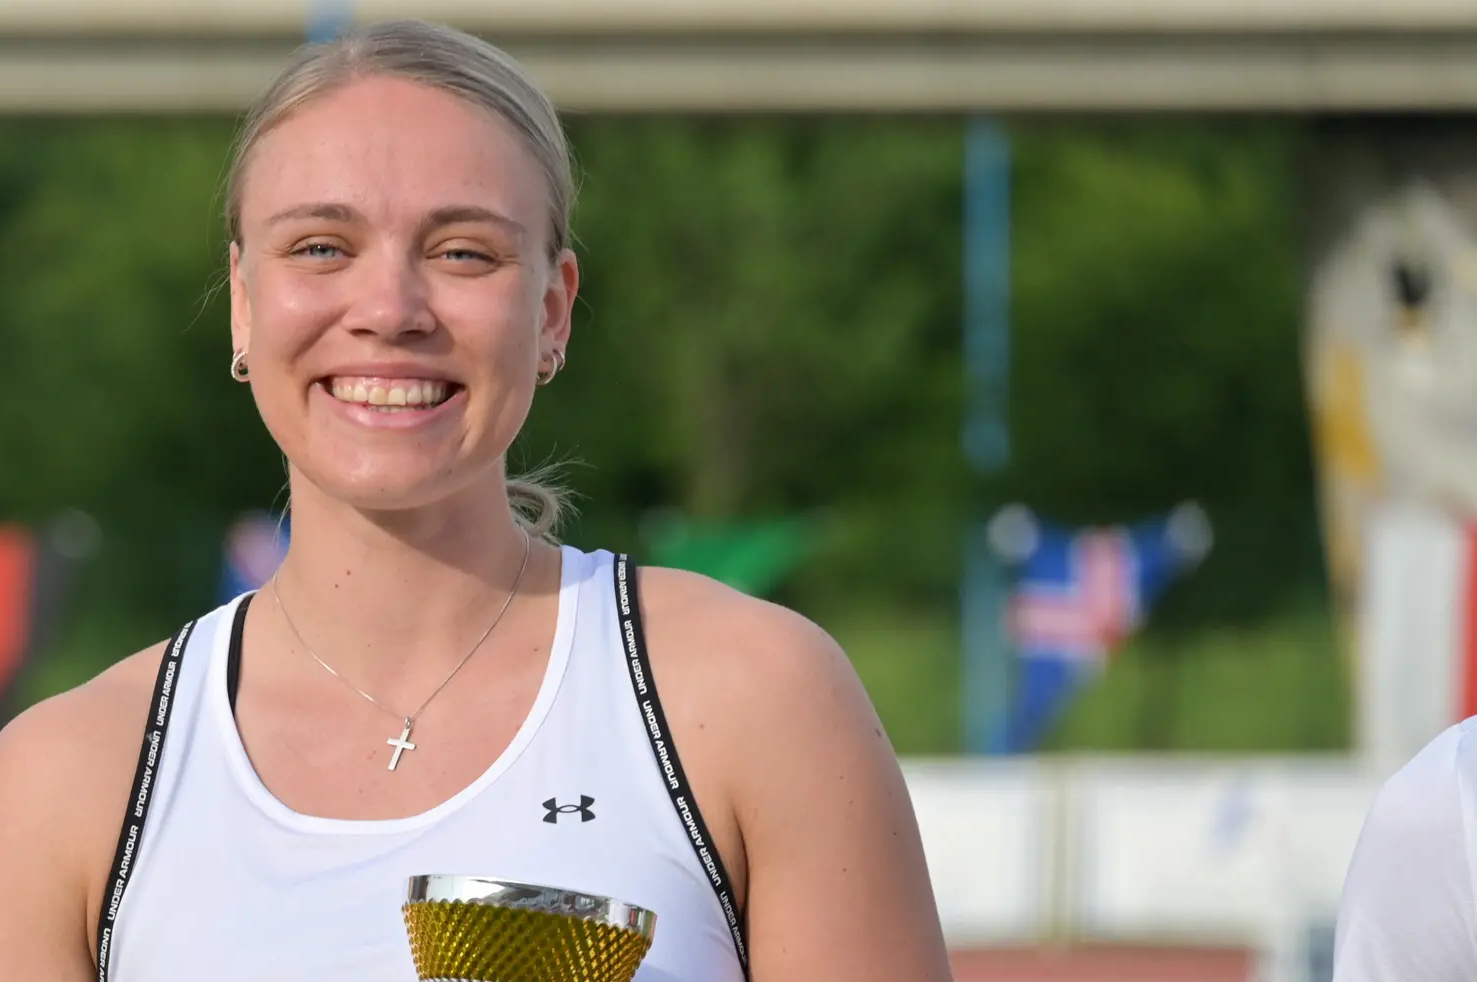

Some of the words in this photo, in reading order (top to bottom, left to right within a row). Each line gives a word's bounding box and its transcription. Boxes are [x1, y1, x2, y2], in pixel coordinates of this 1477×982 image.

[619, 581, 630, 616] ARMOUR
[624, 619, 639, 658] ARMOUR
[155, 695, 169, 727] UNDER
[162, 660, 177, 697] ARMOUR
[632, 658, 648, 695] UNDER
[147, 730, 162, 767] UNDER
[643, 700, 662, 740] UNDER
[655, 740, 679, 790] ARMOUR
[134, 766, 153, 818] ARMOUR
[676, 796, 705, 846] ARMOUR
[107, 878, 125, 921] UNDER
[119, 824, 139, 878] ARMOUR
[699, 846, 722, 887] UNDER
[720, 890, 737, 926] UNDER
[100, 927, 111, 968] UNDER
